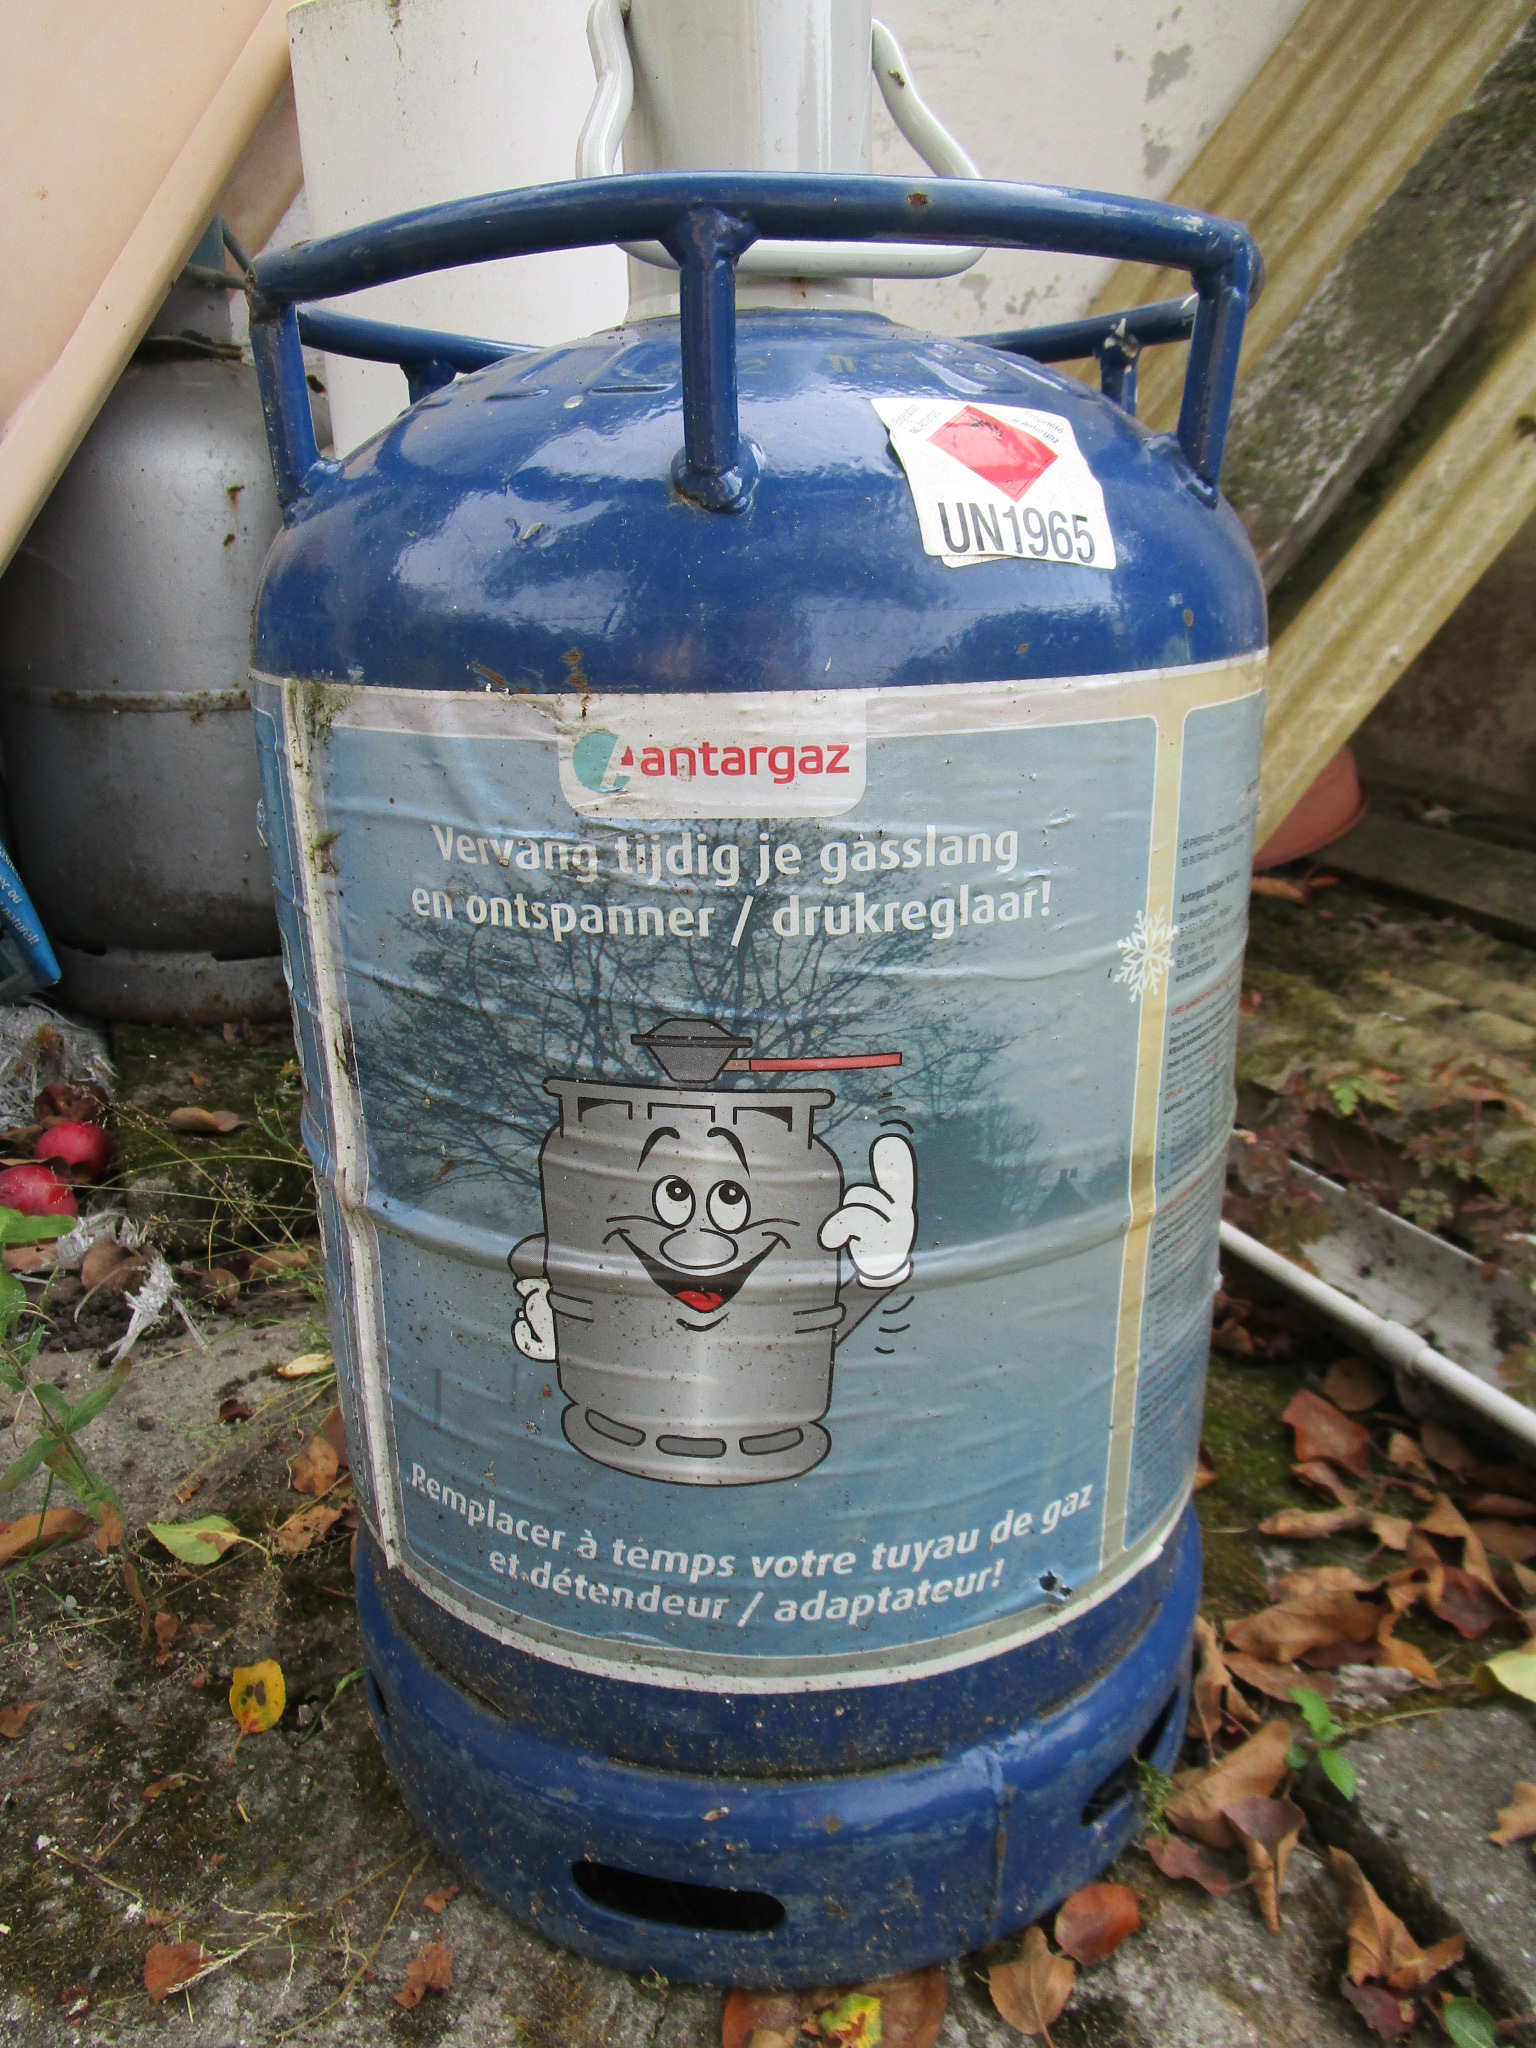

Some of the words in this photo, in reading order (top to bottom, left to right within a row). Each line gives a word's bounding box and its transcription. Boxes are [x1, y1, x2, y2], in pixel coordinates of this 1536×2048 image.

[937, 503, 1096, 564] UN1965
[640, 741, 849, 784] antargaz
[433, 824, 599, 883] Vervang
[614, 833, 741, 887] tijdig
[755, 832, 802, 886] je
[820, 824, 1019, 884] gasslang
[411, 884, 453, 919] en
[466, 894, 715, 943] ontspanner
[730, 895, 756, 947] /
[772, 880, 1052, 940] drukreglaar!
[411, 1464, 566, 1552] Remplacer
[576, 1530, 598, 1559] à
[613, 1539, 736, 1583] temps
[751, 1546, 854, 1579] votre
[871, 1529, 980, 1573] tuyau
[990, 1509, 1033, 1545] de
[1041, 1483, 1094, 1534] gaz
[489, 1549, 521, 1579] et
[529, 1560, 729, 1620] détendeur
[738, 1592, 763, 1628] /
[775, 1559, 1004, 1625] adaptateur!
